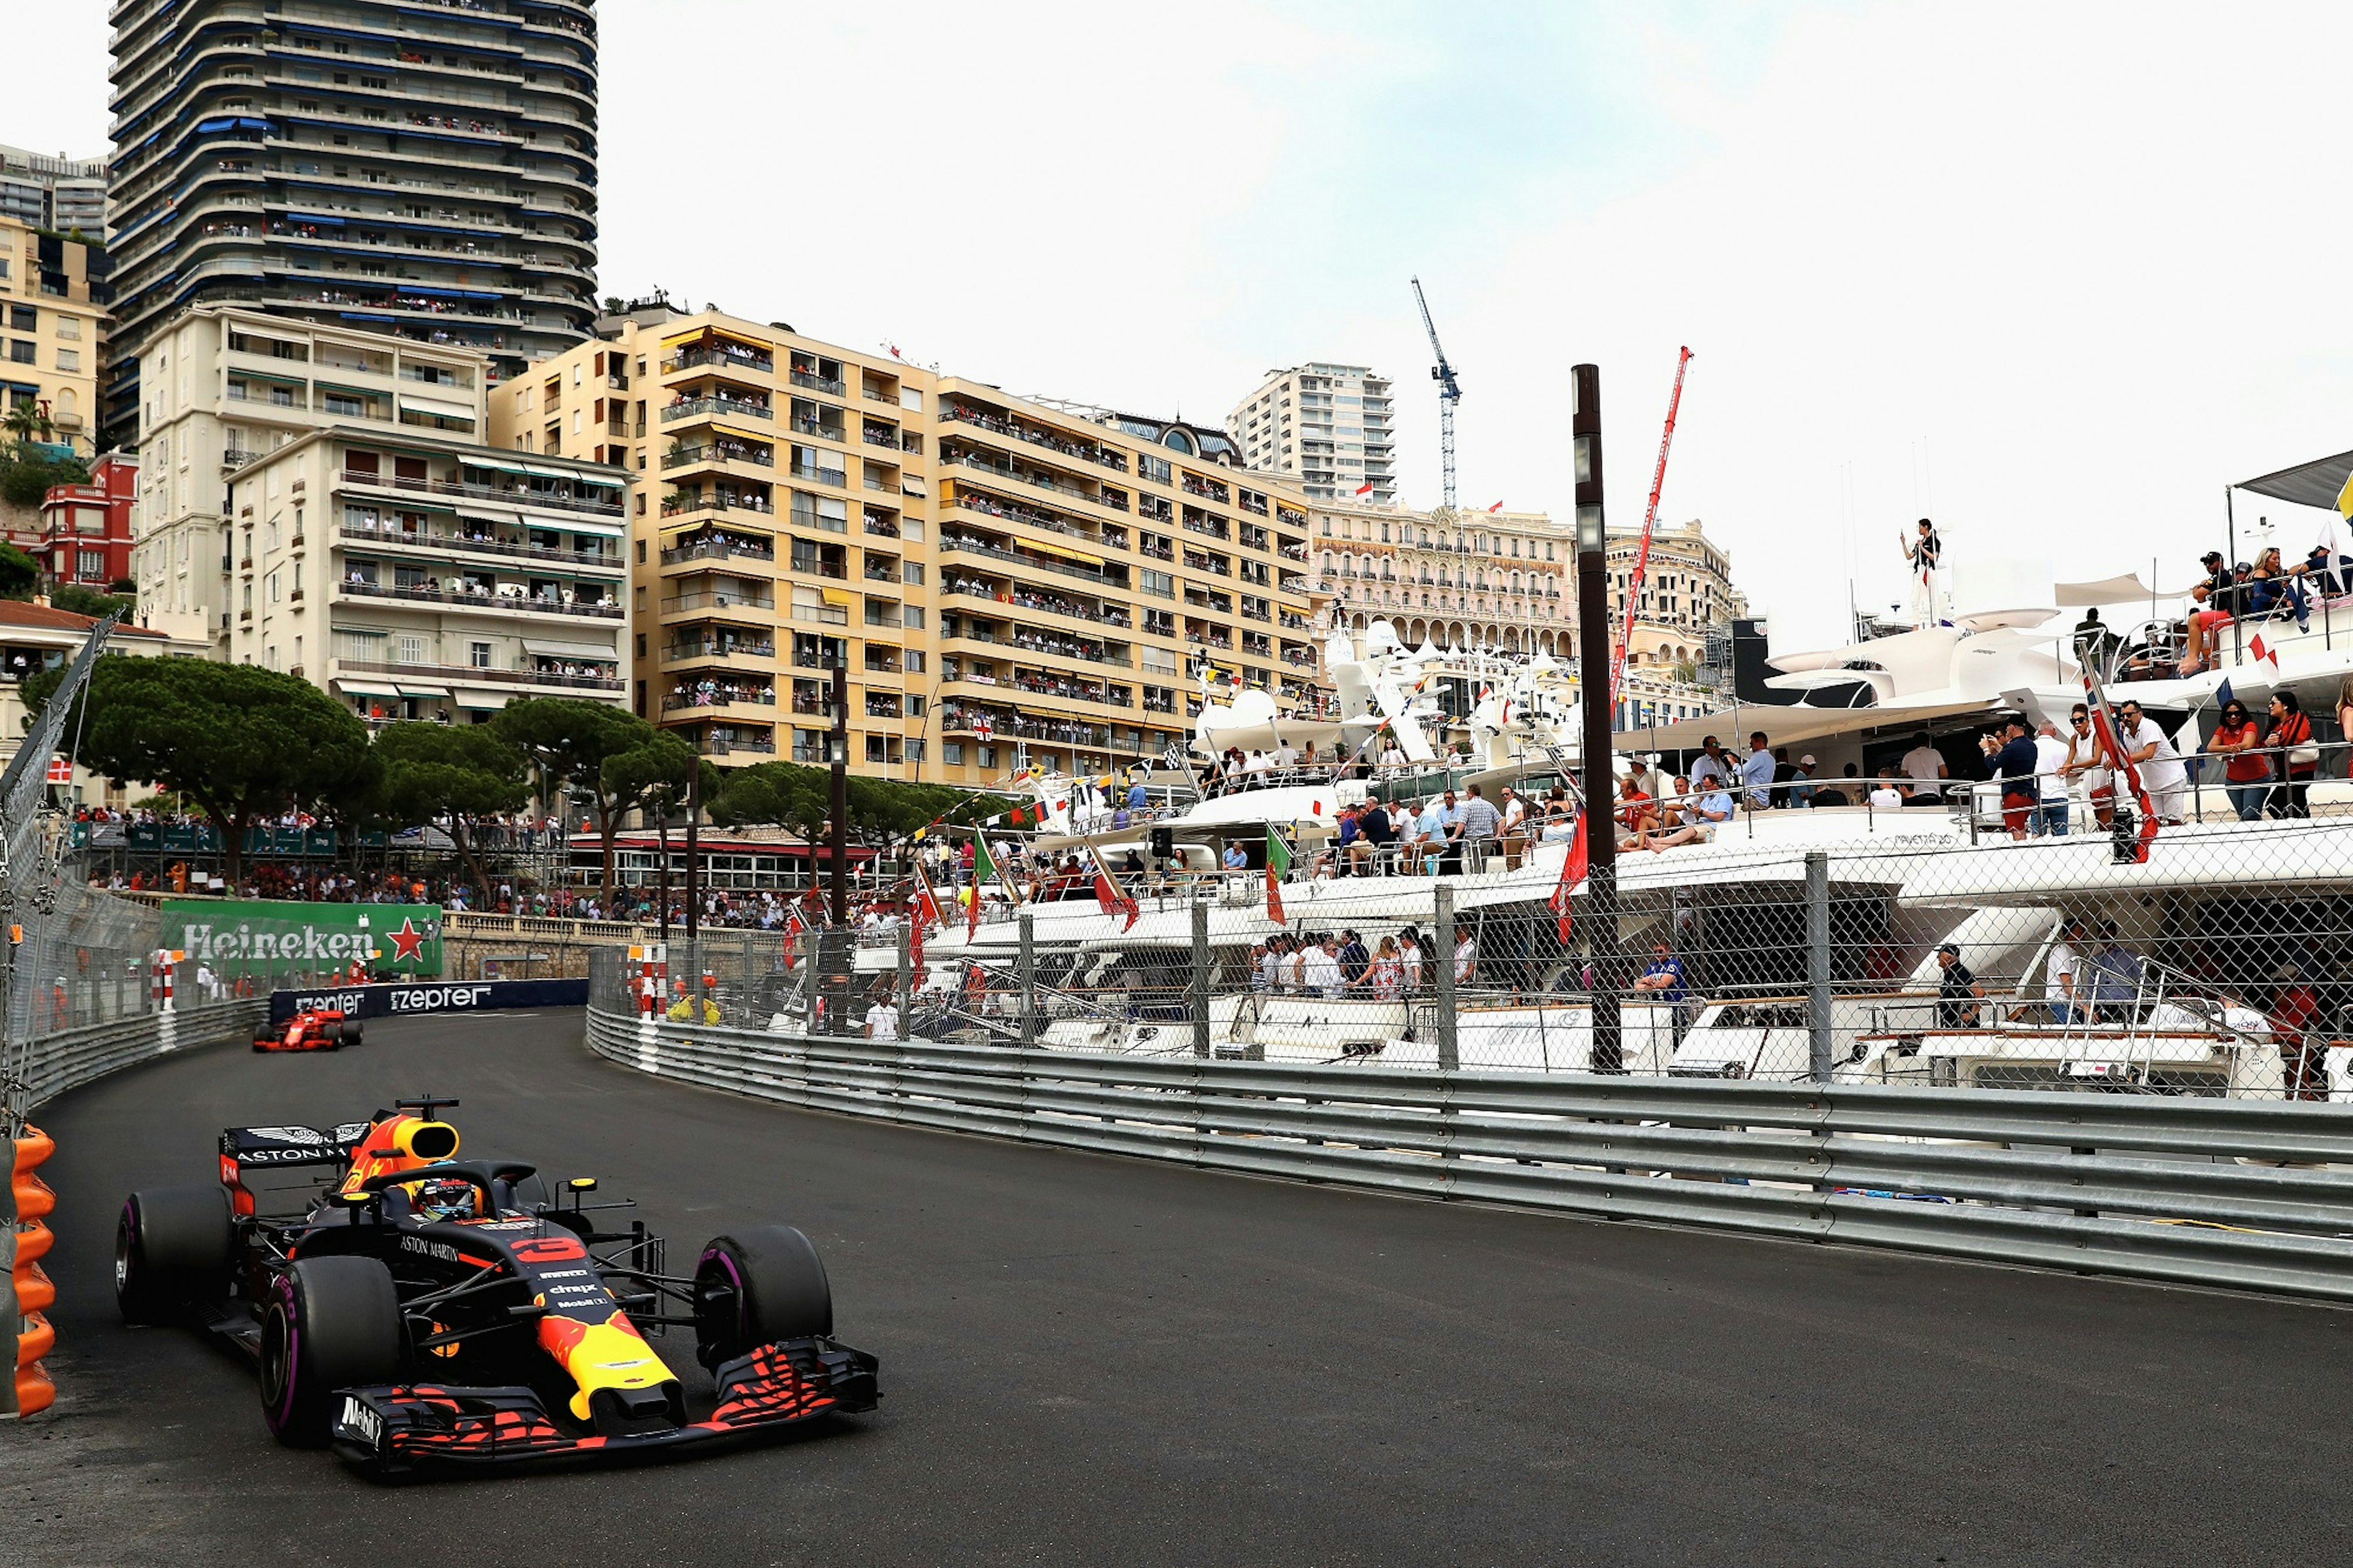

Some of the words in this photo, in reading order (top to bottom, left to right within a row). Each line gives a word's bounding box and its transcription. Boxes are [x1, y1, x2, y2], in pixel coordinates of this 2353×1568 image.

[182, 923, 376, 960] Heineken
[397, 987, 491, 1010] zepter
[237, 1148, 321, 1163] ASTON
[400, 1235, 428, 1254] ASTON
[430, 1241, 459, 1263] MARTIN
[510, 1236, 587, 1263] 3
[557, 1299, 593, 1309] Mobil
[341, 1396, 376, 1442] Mobil
